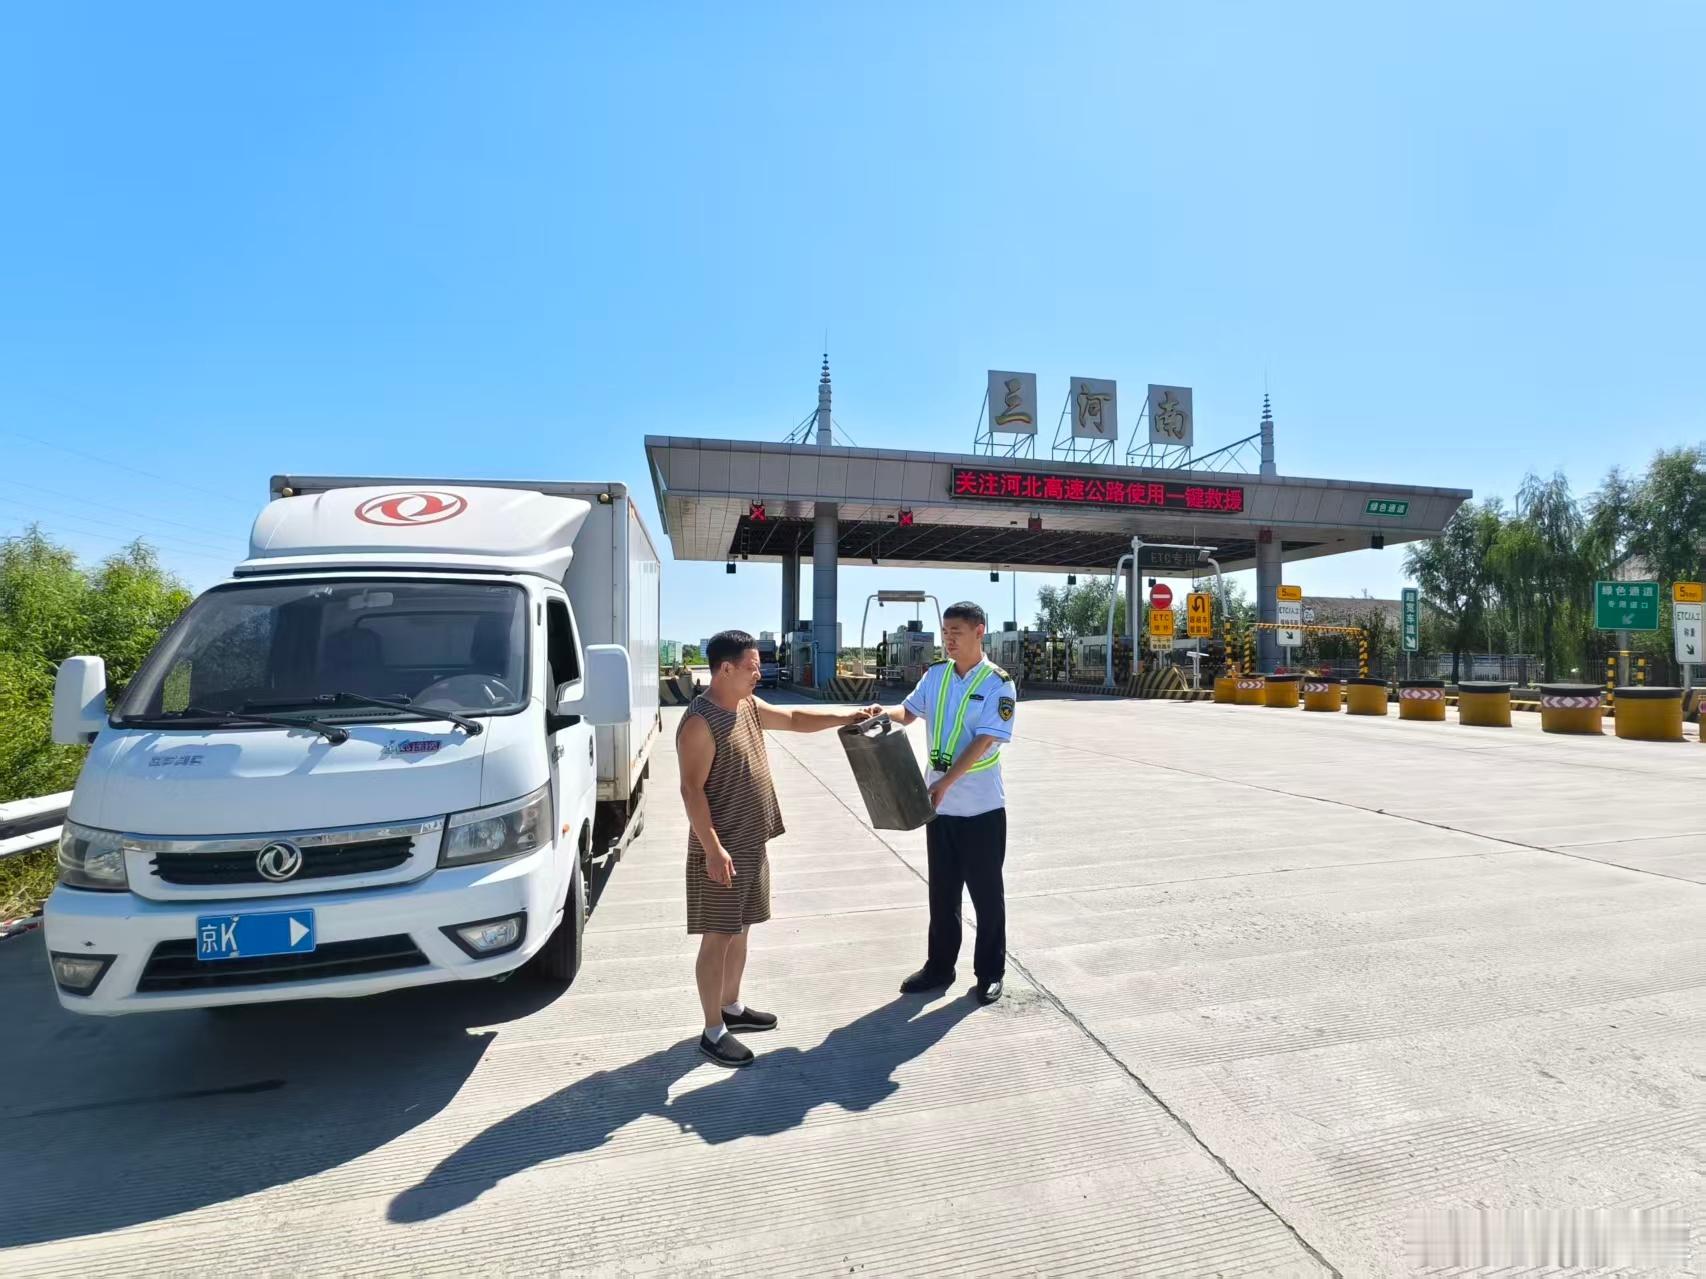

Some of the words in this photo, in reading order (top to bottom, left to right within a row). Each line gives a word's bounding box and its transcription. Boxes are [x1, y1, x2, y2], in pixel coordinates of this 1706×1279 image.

[995, 377, 1188, 440] 三河南
[955, 471, 1243, 511] 关注河北高速公路使用一键救援
[1601, 585, 1653, 597] 绿色通道
[1153, 613, 1169, 621] ETC
